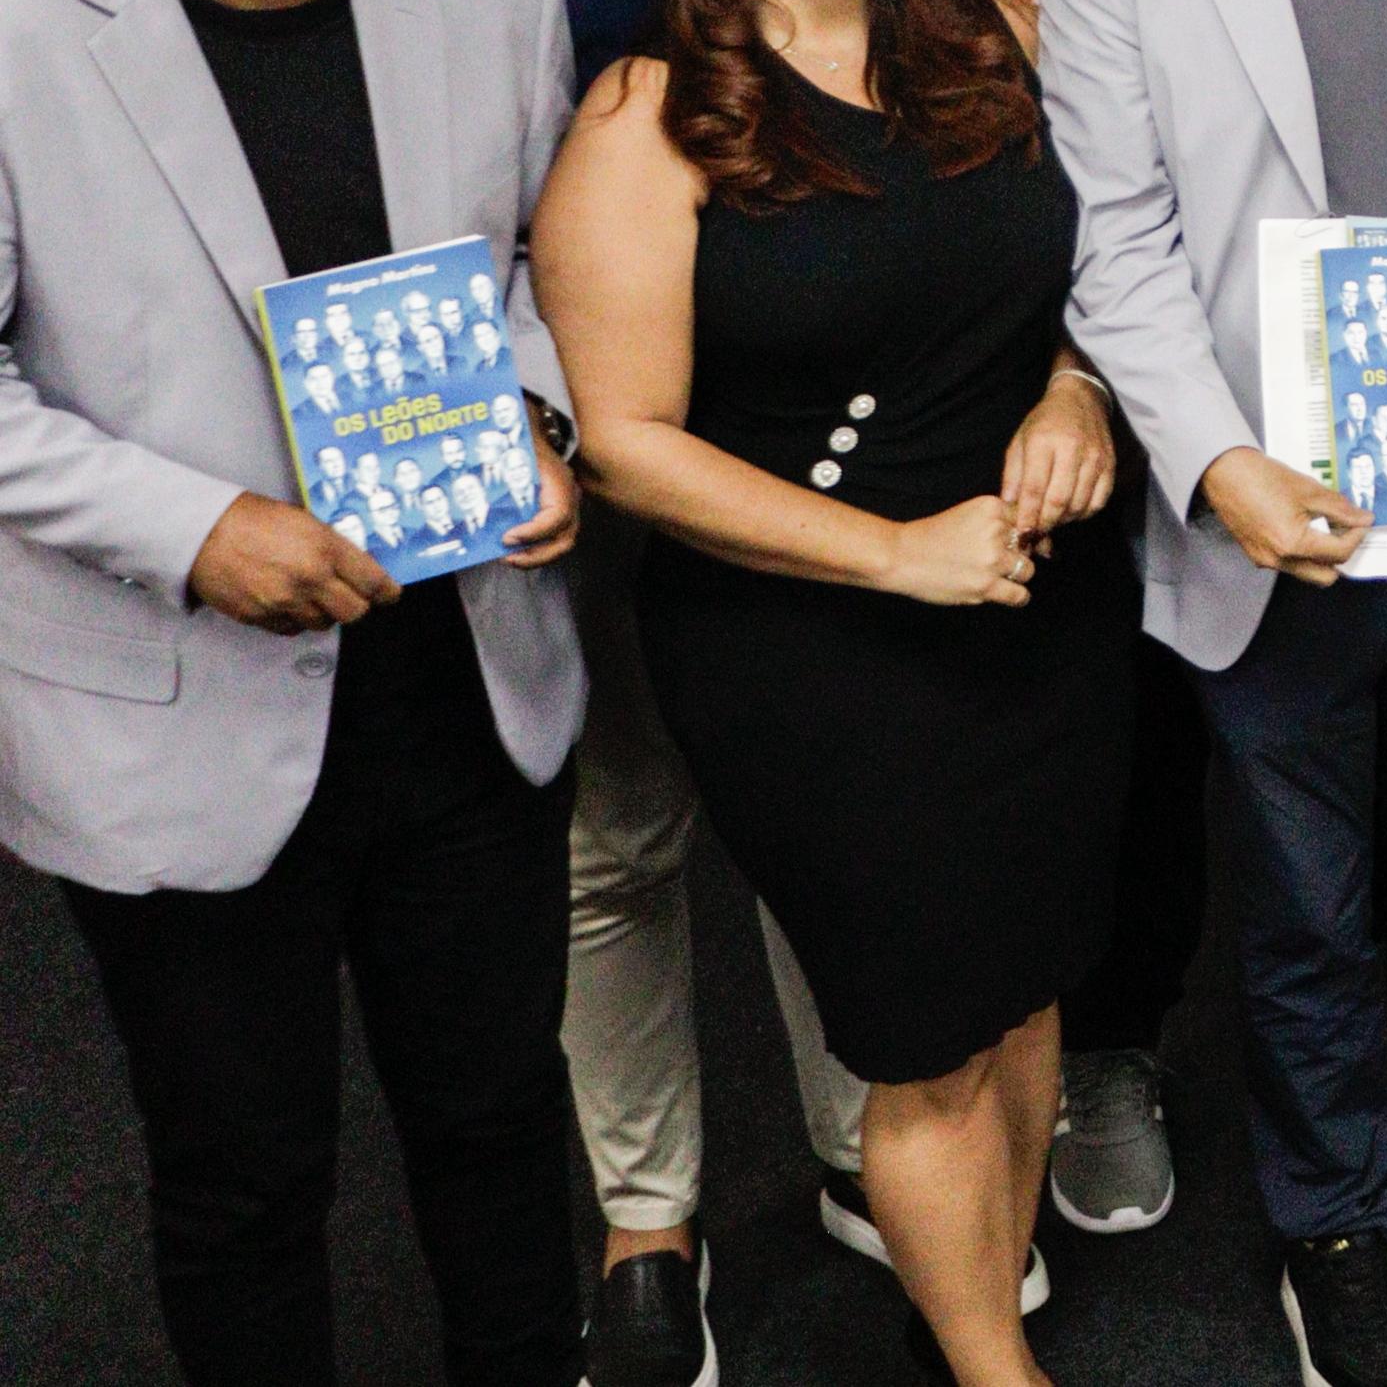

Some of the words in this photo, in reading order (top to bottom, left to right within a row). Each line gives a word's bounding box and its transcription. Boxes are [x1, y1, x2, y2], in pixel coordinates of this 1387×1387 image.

[1363, 369, 1387, 386] OS
[334, 413, 367, 437] OS
[383, 422, 414, 446] DO
